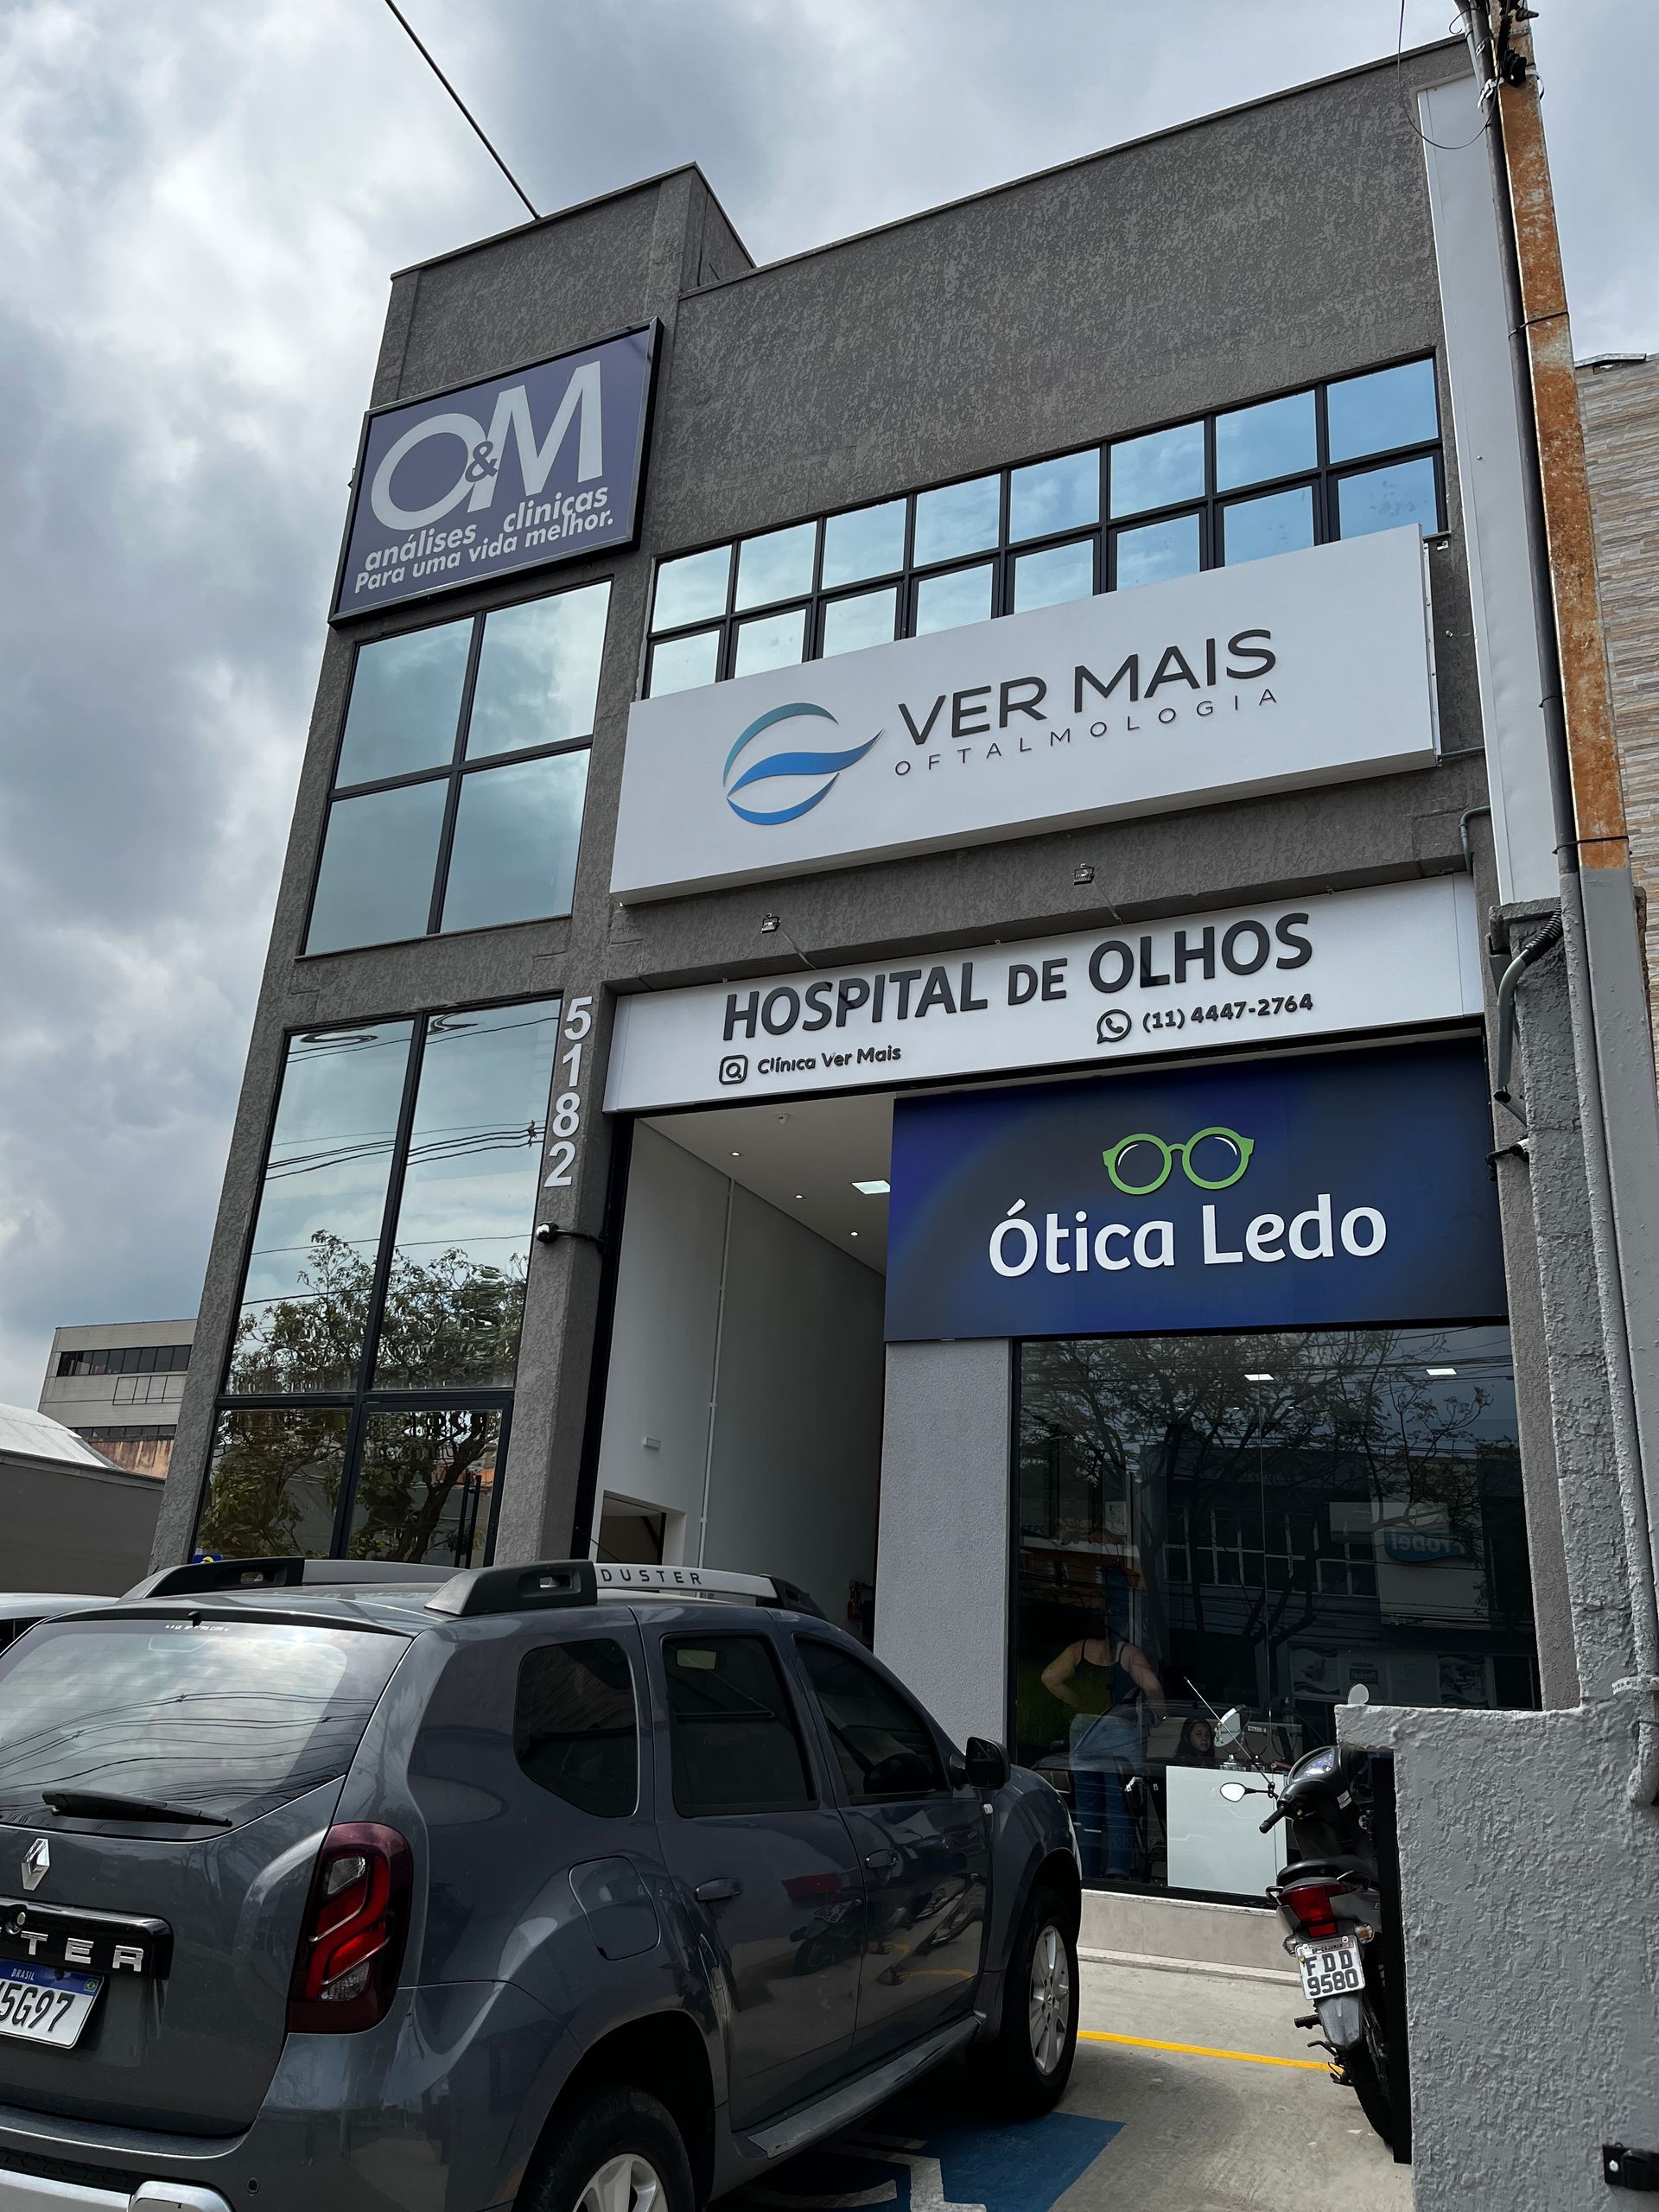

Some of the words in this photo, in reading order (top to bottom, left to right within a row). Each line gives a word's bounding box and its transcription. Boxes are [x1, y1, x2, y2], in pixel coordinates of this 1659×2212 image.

[371, 359, 603, 531] O&M
[354, 566, 405, 594] Para
[412, 551, 461, 577] uma
[468, 534, 518, 563] vida
[524, 509, 613, 548] melhor.
[365, 523, 477, 572] análises
[503, 486, 608, 533] clinicas
[898, 676, 1048, 747] VER
[1074, 628, 1277, 714] MAIS
[894, 689, 1277, 777] OFTALMOLOGIA
[722, 962, 988, 1041] HOSPITAL
[1007, 957, 1068, 1006] DE
[1088, 912, 1313, 994] OLHOS
[1142, 1008, 1185, 1033] (11)
[1190, 993, 1314, 1024] 4447-2764
[821, 1048, 853, 1068] Ver
[856, 1044, 902, 1065] Mais
[543, 995, 593, 1188] 5182
[988, 1198, 1175, 1277] Ótica
[1202, 1192, 1388, 1265] Ledo
[601, 1568, 702, 1586] DUSTER
[0, 1926, 144, 1972] TER
[10, 1967, 35, 1981] BRASIL
[1305, 1949, 1353, 1976] FDD
[1306, 1968, 1359, 1997] 9580
[0, 1981, 75, 2032] 5G97
